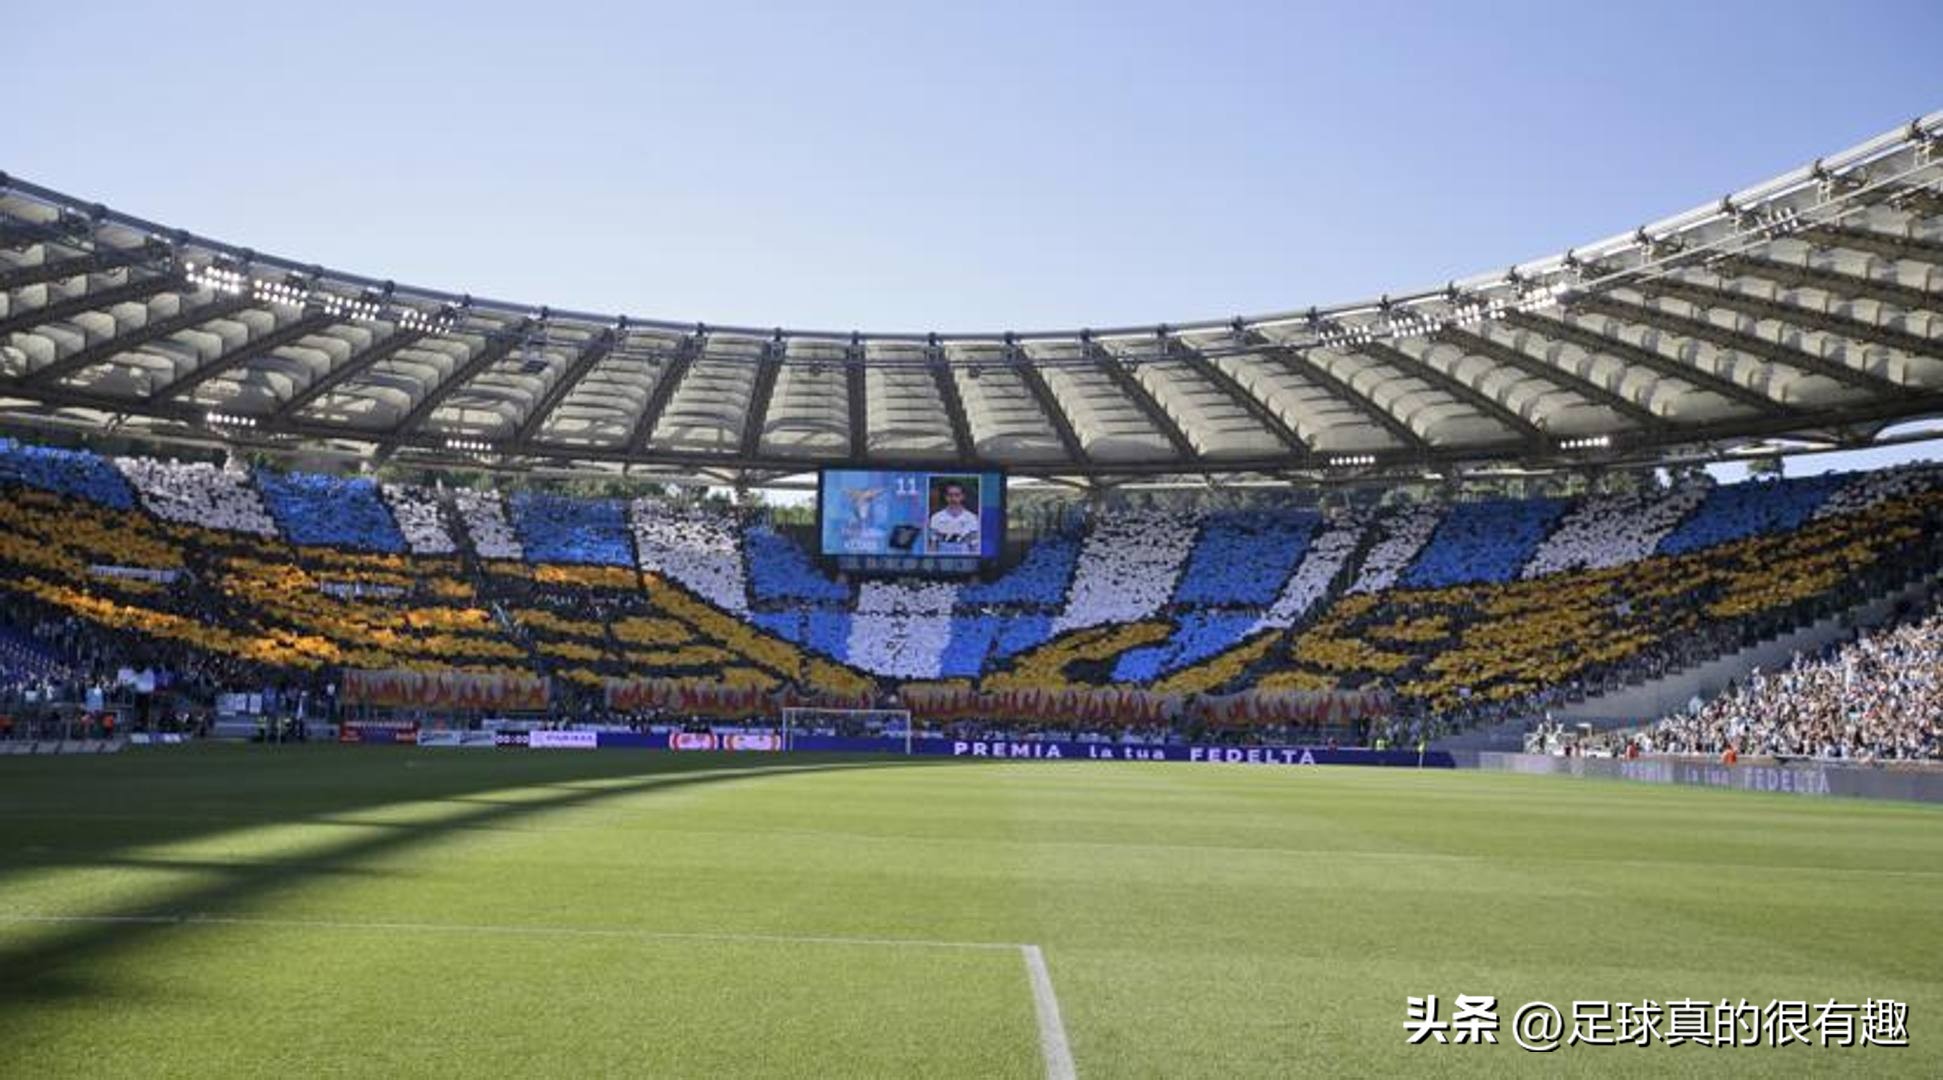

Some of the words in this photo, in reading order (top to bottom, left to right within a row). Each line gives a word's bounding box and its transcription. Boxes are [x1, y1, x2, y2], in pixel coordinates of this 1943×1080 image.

[896, 478, 918, 495] 11
[954, 741, 1061, 758] PREMIA
[1089, 745, 1114, 758] la
[1124, 744, 1165, 760] tua
